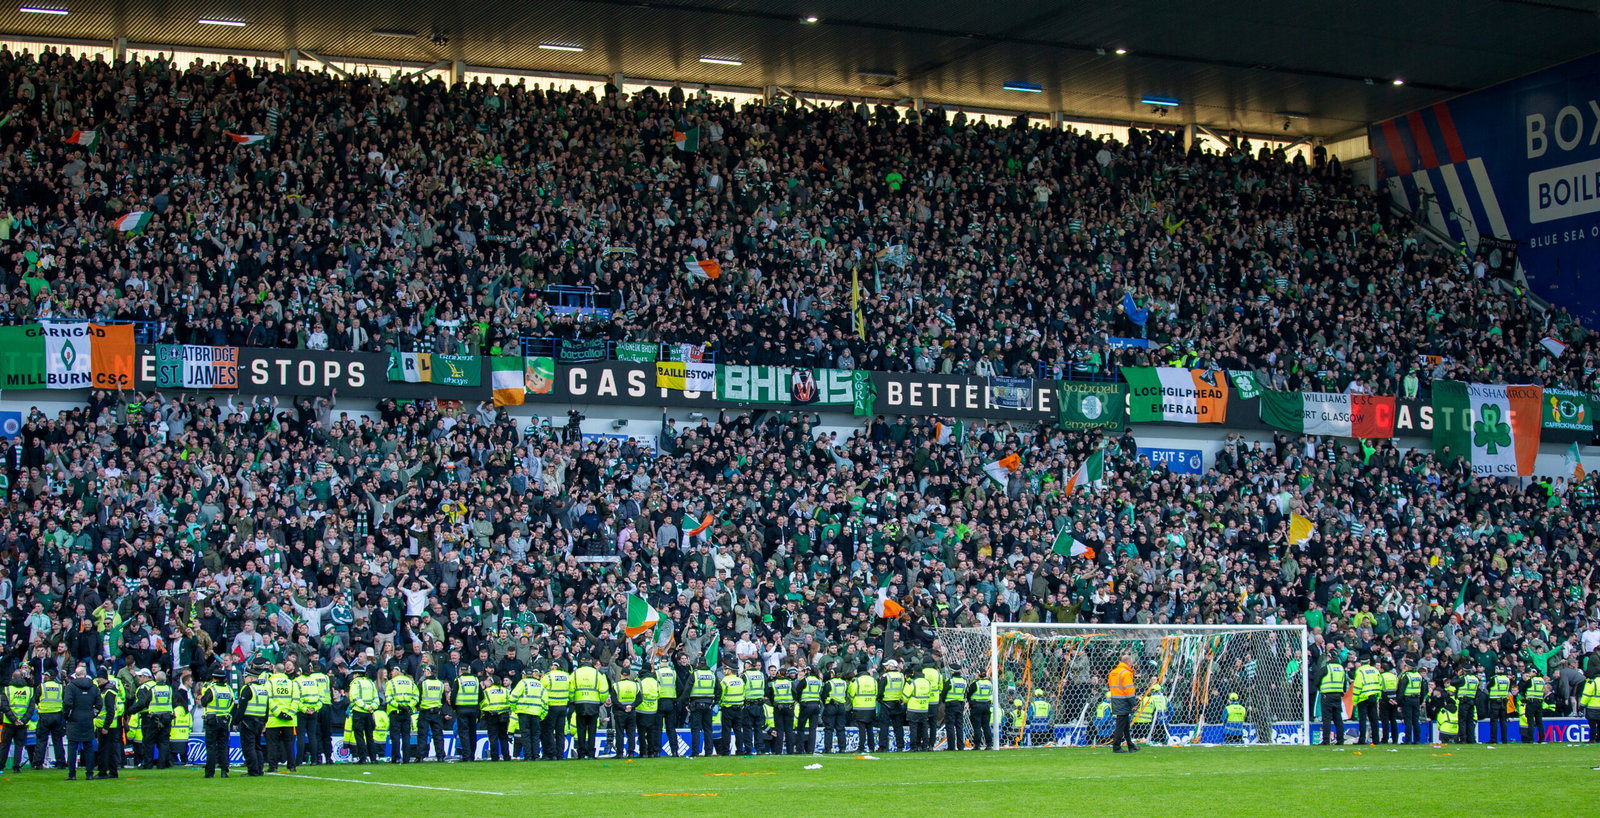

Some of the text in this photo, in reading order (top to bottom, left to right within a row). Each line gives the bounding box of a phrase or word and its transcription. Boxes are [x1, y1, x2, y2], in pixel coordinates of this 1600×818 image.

[1530, 234, 1558, 248] BLUE
[1563, 229, 1585, 242] SEA
[25, 326, 106, 338] GARNGAD
[7, 371, 128, 385] MILLBURN CSC
[160, 365, 236, 385] ST. JAMES
[251, 359, 366, 388] STOPS
[657, 366, 715, 380] BAILLIESTON
[1063, 382, 1119, 394] bothwell
[1134, 386, 1223, 399] LOCHGILPHEAD
[1483, 386, 1539, 400] SHAMROCK
[1303, 393, 1347, 404] WILLIAMS
[1353, 395, 1373, 405] CSC
[1151, 403, 1208, 415] EMERALD
[1321, 411, 1365, 423] GLASGOW
[1152, 450, 1186, 463] EXIT 5
[1497, 463, 1517, 474] csc
